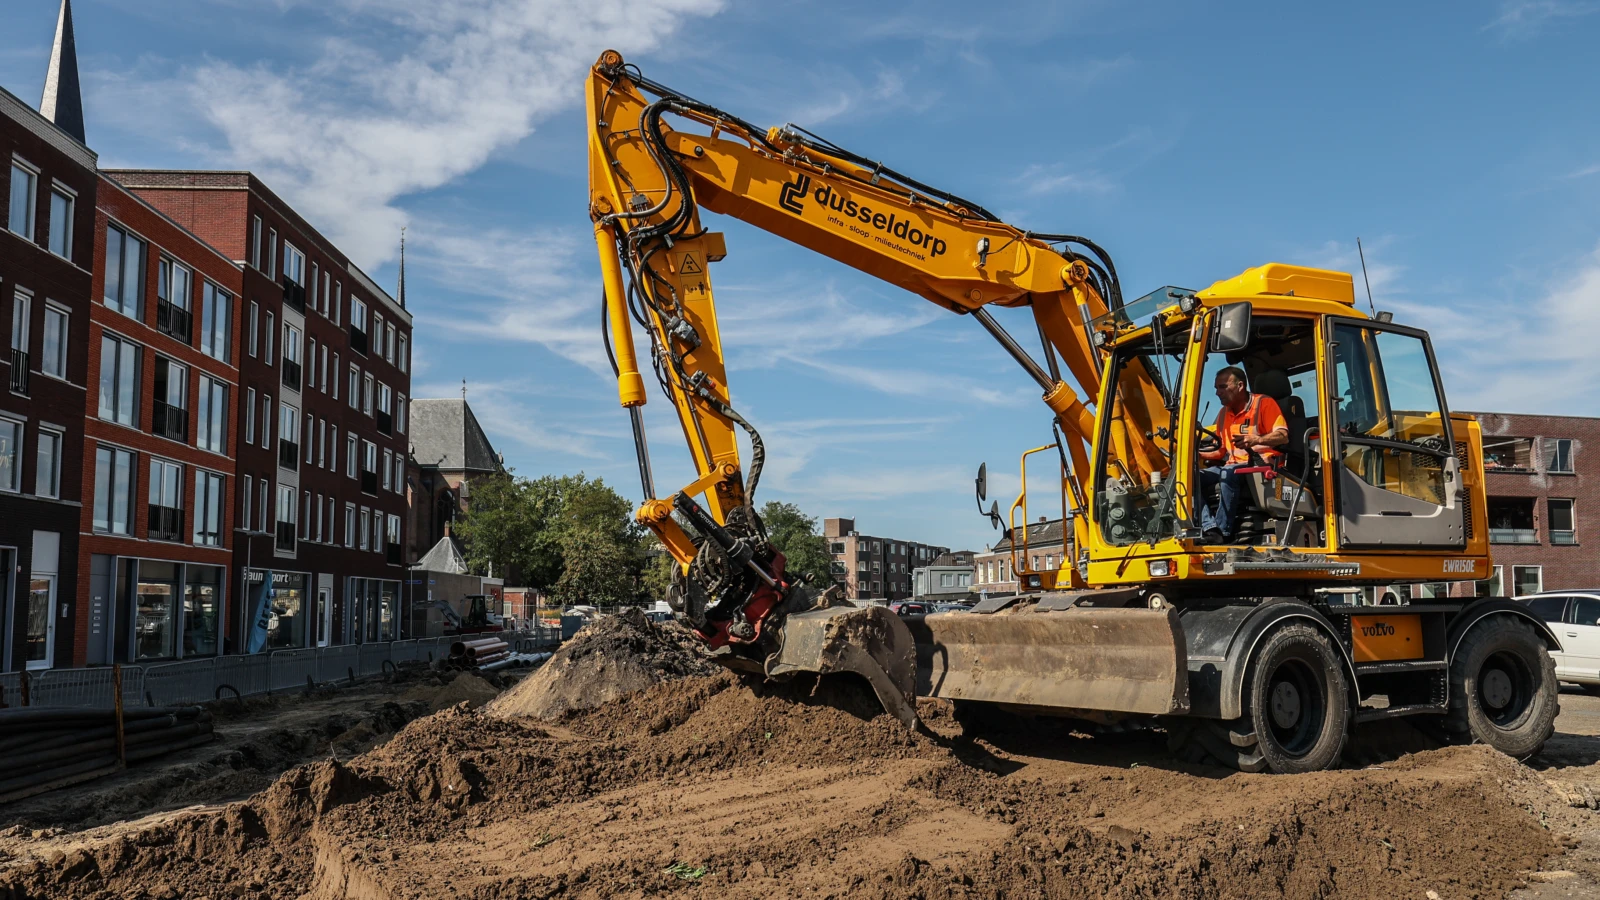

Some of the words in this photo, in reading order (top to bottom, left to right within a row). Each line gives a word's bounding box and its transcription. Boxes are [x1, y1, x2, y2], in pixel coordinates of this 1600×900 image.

[814, 186, 947, 257] dusseldorp
[827, 214, 844, 227] infra
[849, 224, 870, 238] sloop
[875, 235, 926, 262] milieutechniek
[1443, 559, 1475, 573] EWR150E
[1361, 625, 1395, 637] VOLVO
